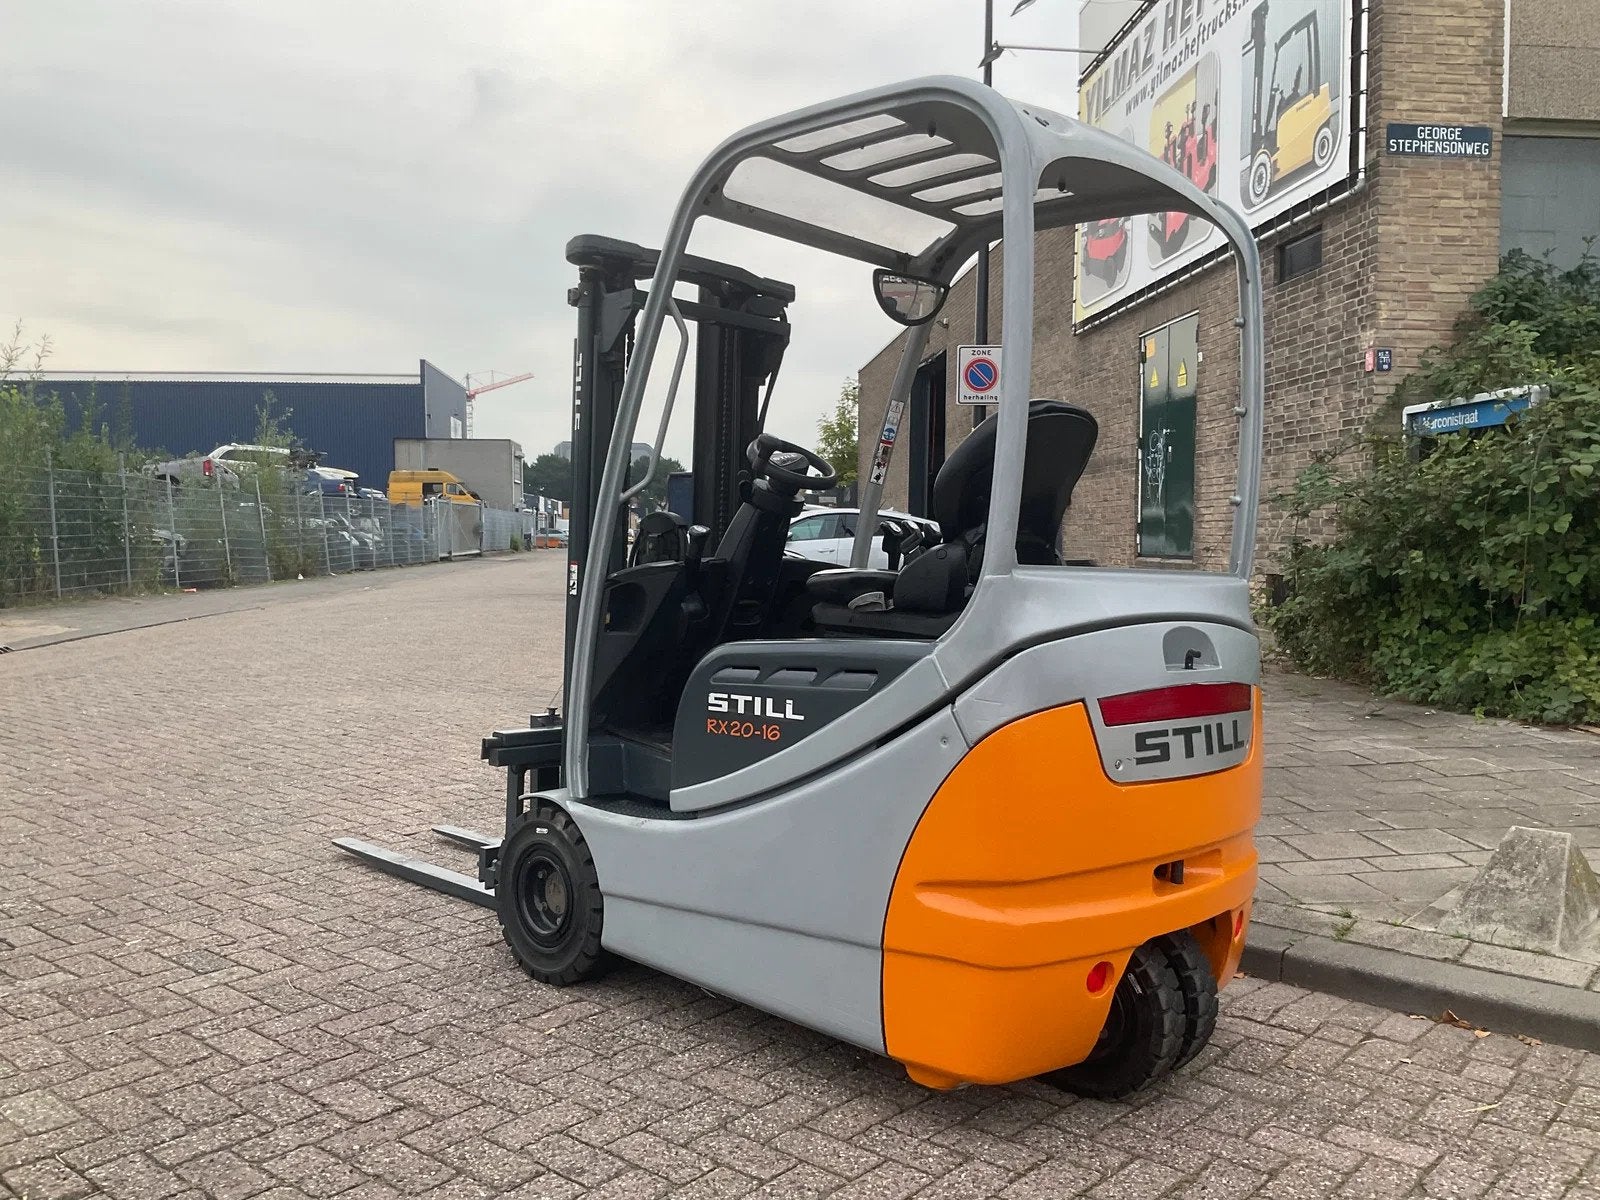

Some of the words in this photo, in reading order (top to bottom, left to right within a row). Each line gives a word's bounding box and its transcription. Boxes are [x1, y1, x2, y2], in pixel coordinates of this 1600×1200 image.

[1085, 16, 1157, 126] YILMAZ
[1416, 126, 1463, 140] GEORGE
[1389, 139, 1490, 156] STEPHENSONWEG
[963, 394, 999, 402] herhaling
[708, 692, 805, 721] STILL
[1134, 719, 1245, 766] STILL
